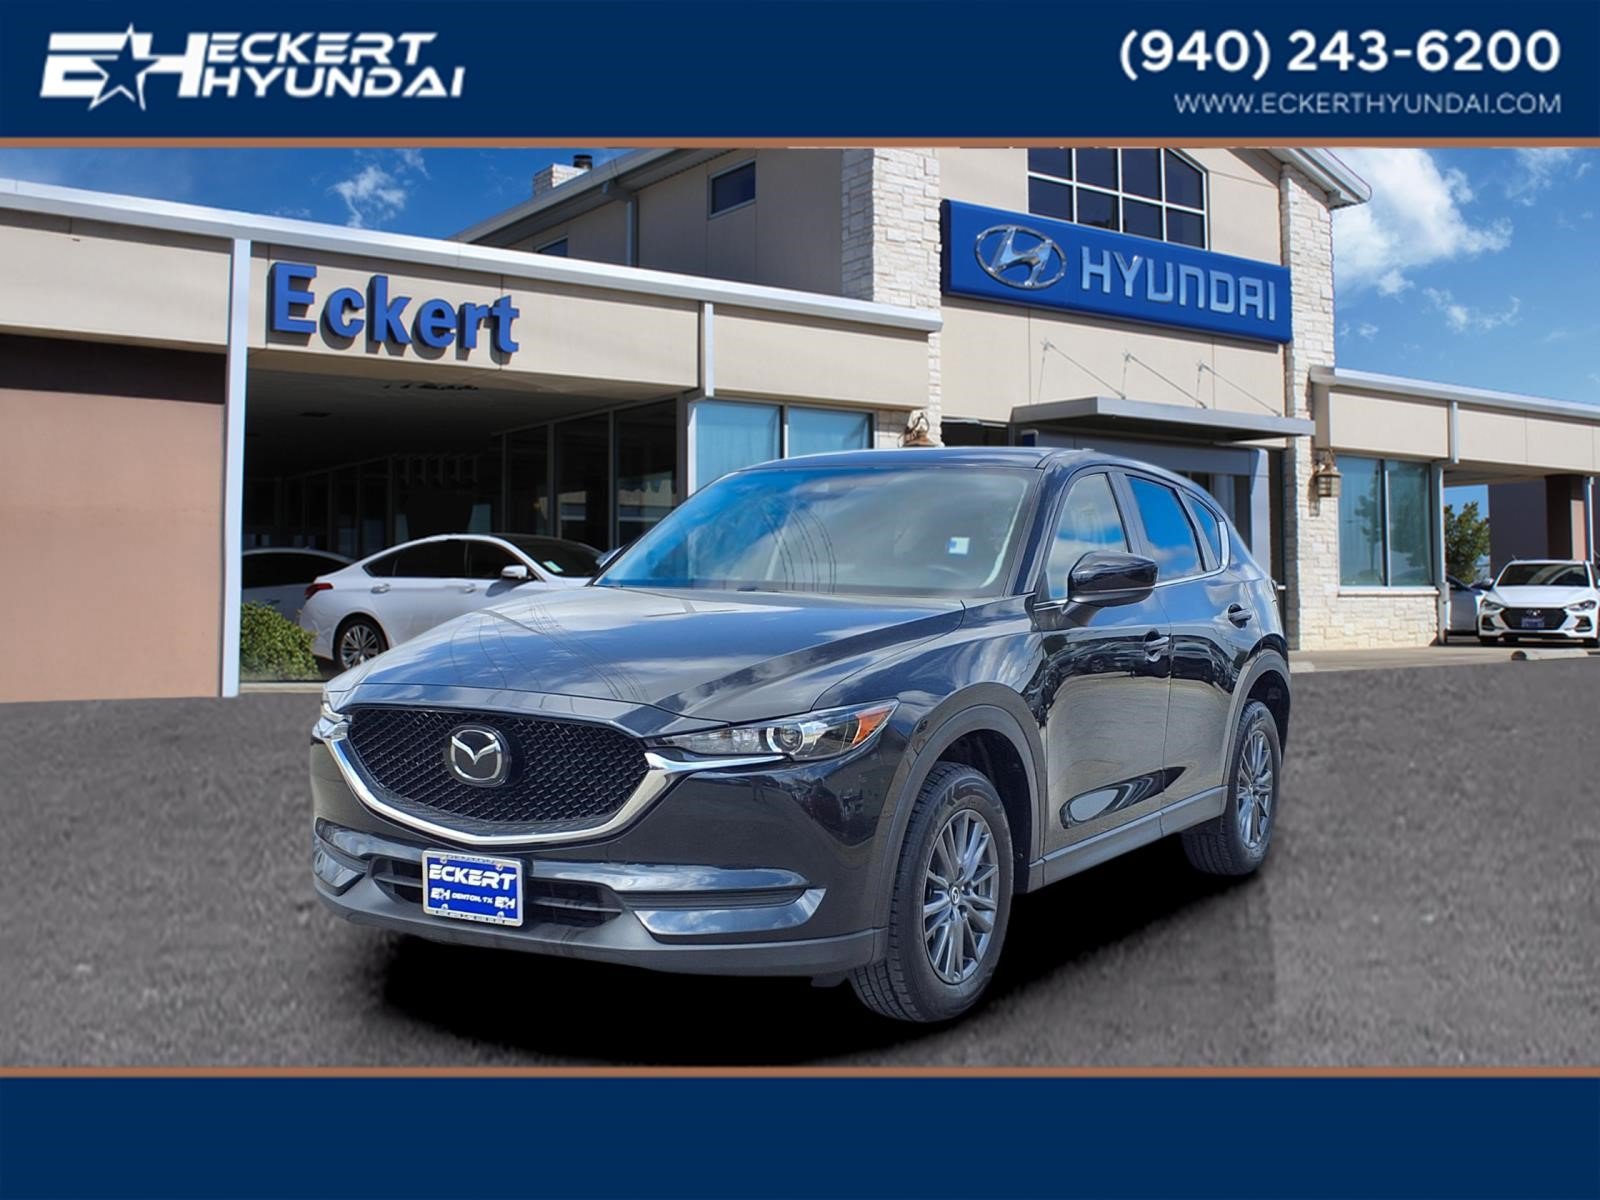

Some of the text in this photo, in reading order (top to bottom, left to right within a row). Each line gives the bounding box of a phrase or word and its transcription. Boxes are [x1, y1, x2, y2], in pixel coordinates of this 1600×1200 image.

[268, 262, 520, 353] Eckert
[1081, 246, 1276, 321] HYUNDAI
[429, 864, 517, 890] ECKERT
